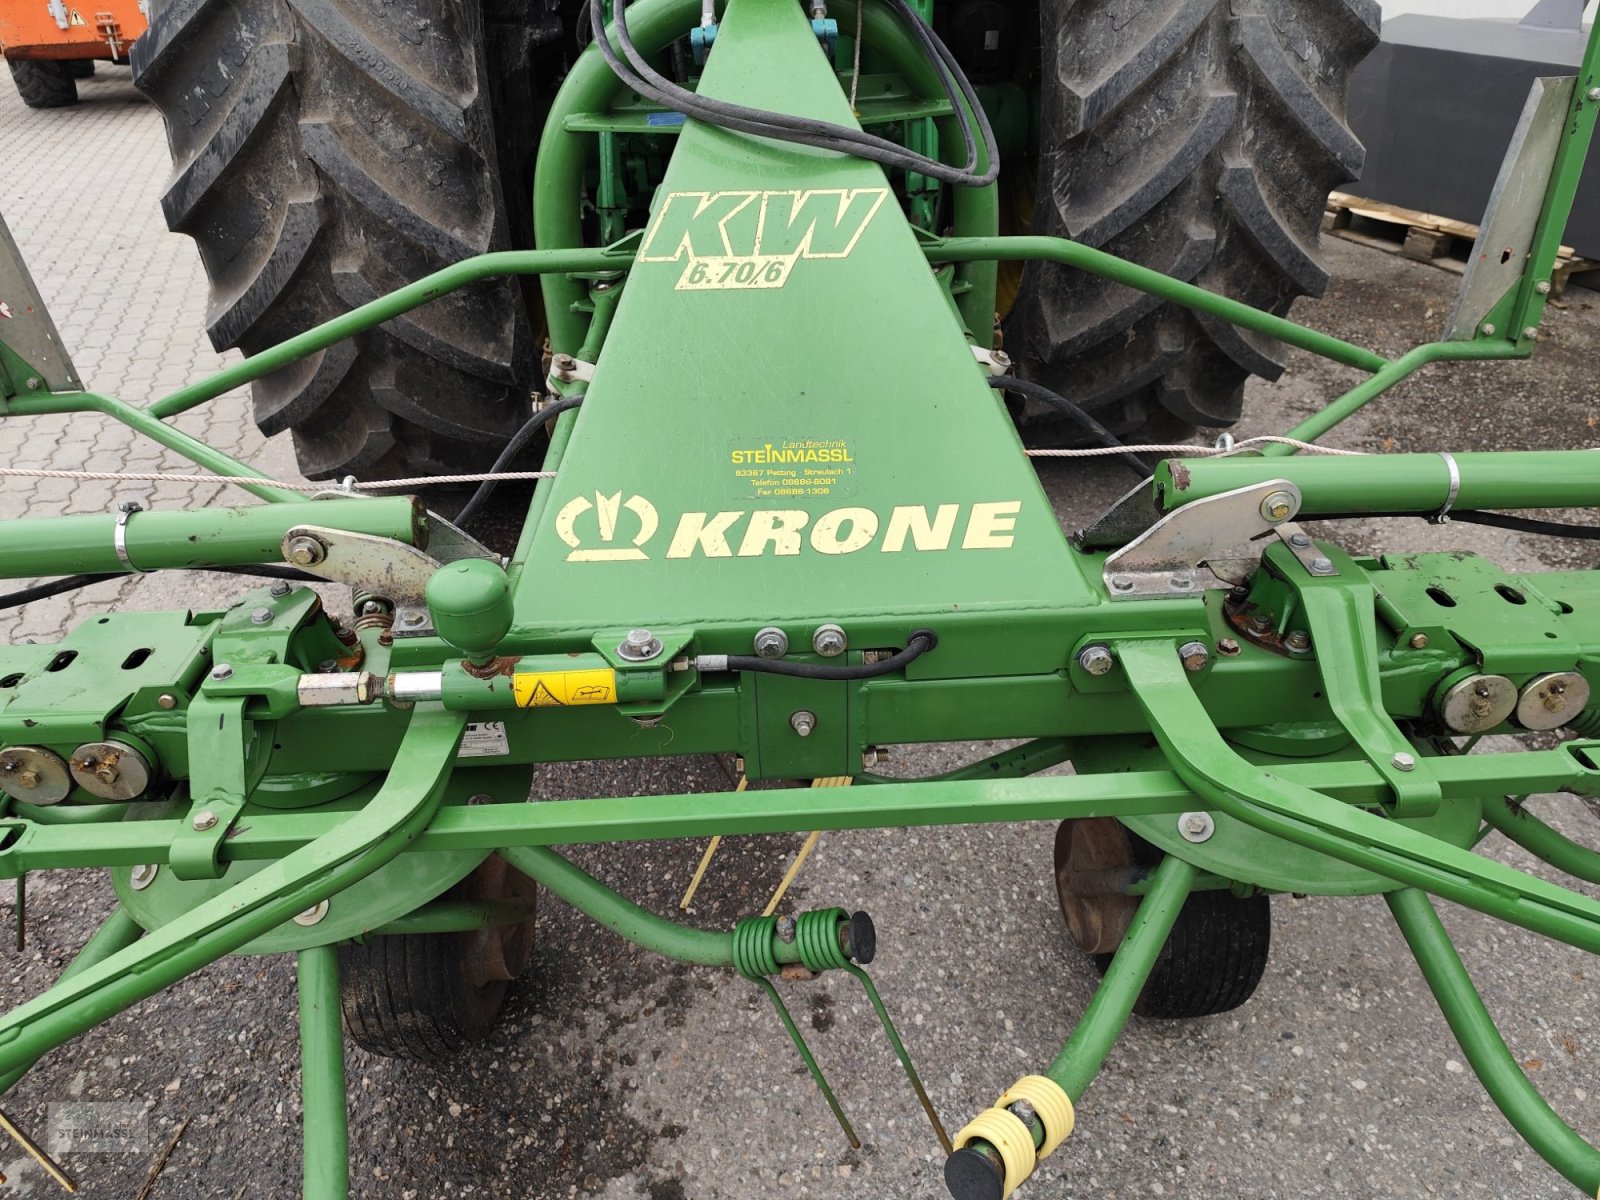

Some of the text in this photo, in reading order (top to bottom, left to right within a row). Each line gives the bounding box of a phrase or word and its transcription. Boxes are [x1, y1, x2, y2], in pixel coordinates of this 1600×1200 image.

[637, 188, 889, 262] KW
[688, 261, 785, 285] 6.70/6
[732, 444, 853, 464] STEINMASSL
[782, 440, 847, 449] Landtechnik
[735, 469, 764, 477] 83367
[767, 469, 797, 478] Petting
[751, 479, 780, 487] Telefon
[664, 500, 1022, 560] KRONE
